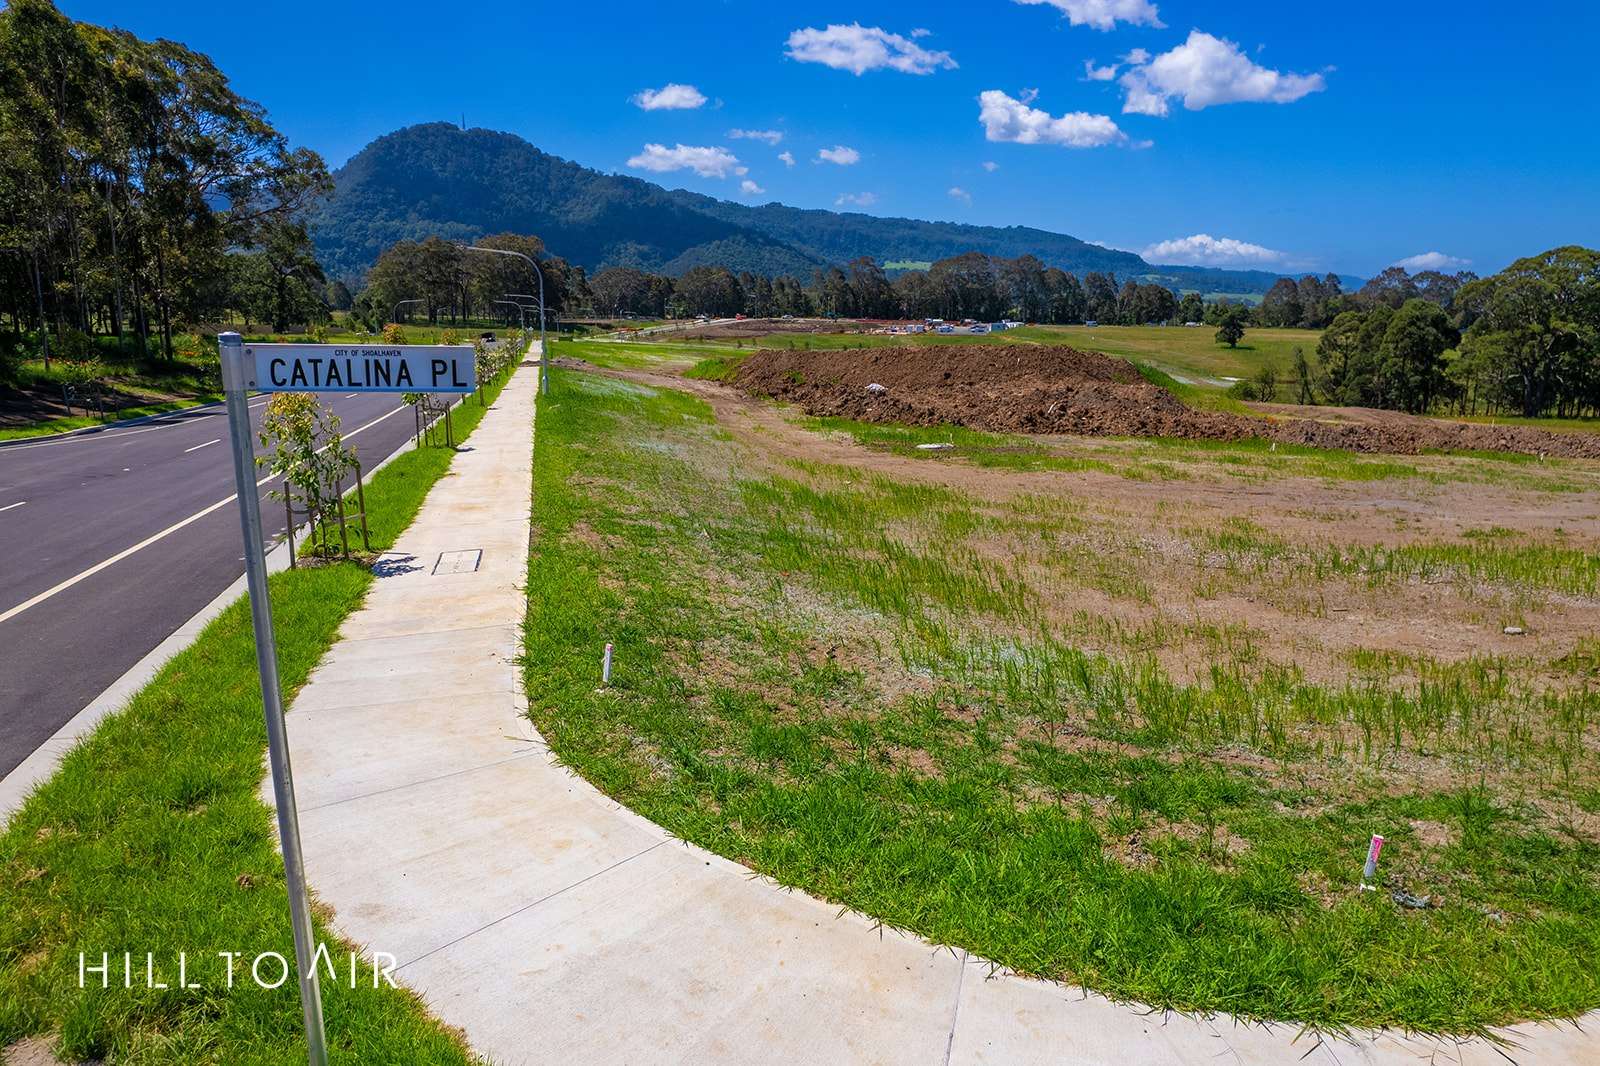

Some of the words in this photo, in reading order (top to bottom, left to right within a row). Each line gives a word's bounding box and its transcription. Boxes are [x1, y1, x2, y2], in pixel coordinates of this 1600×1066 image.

[334, 349, 348, 357] CITY
[350, 349, 359, 357] OF
[361, 349, 402, 357] SHOALHAVEN
[270, 358, 414, 387] CATALINA
[431, 358, 467, 387] PL
